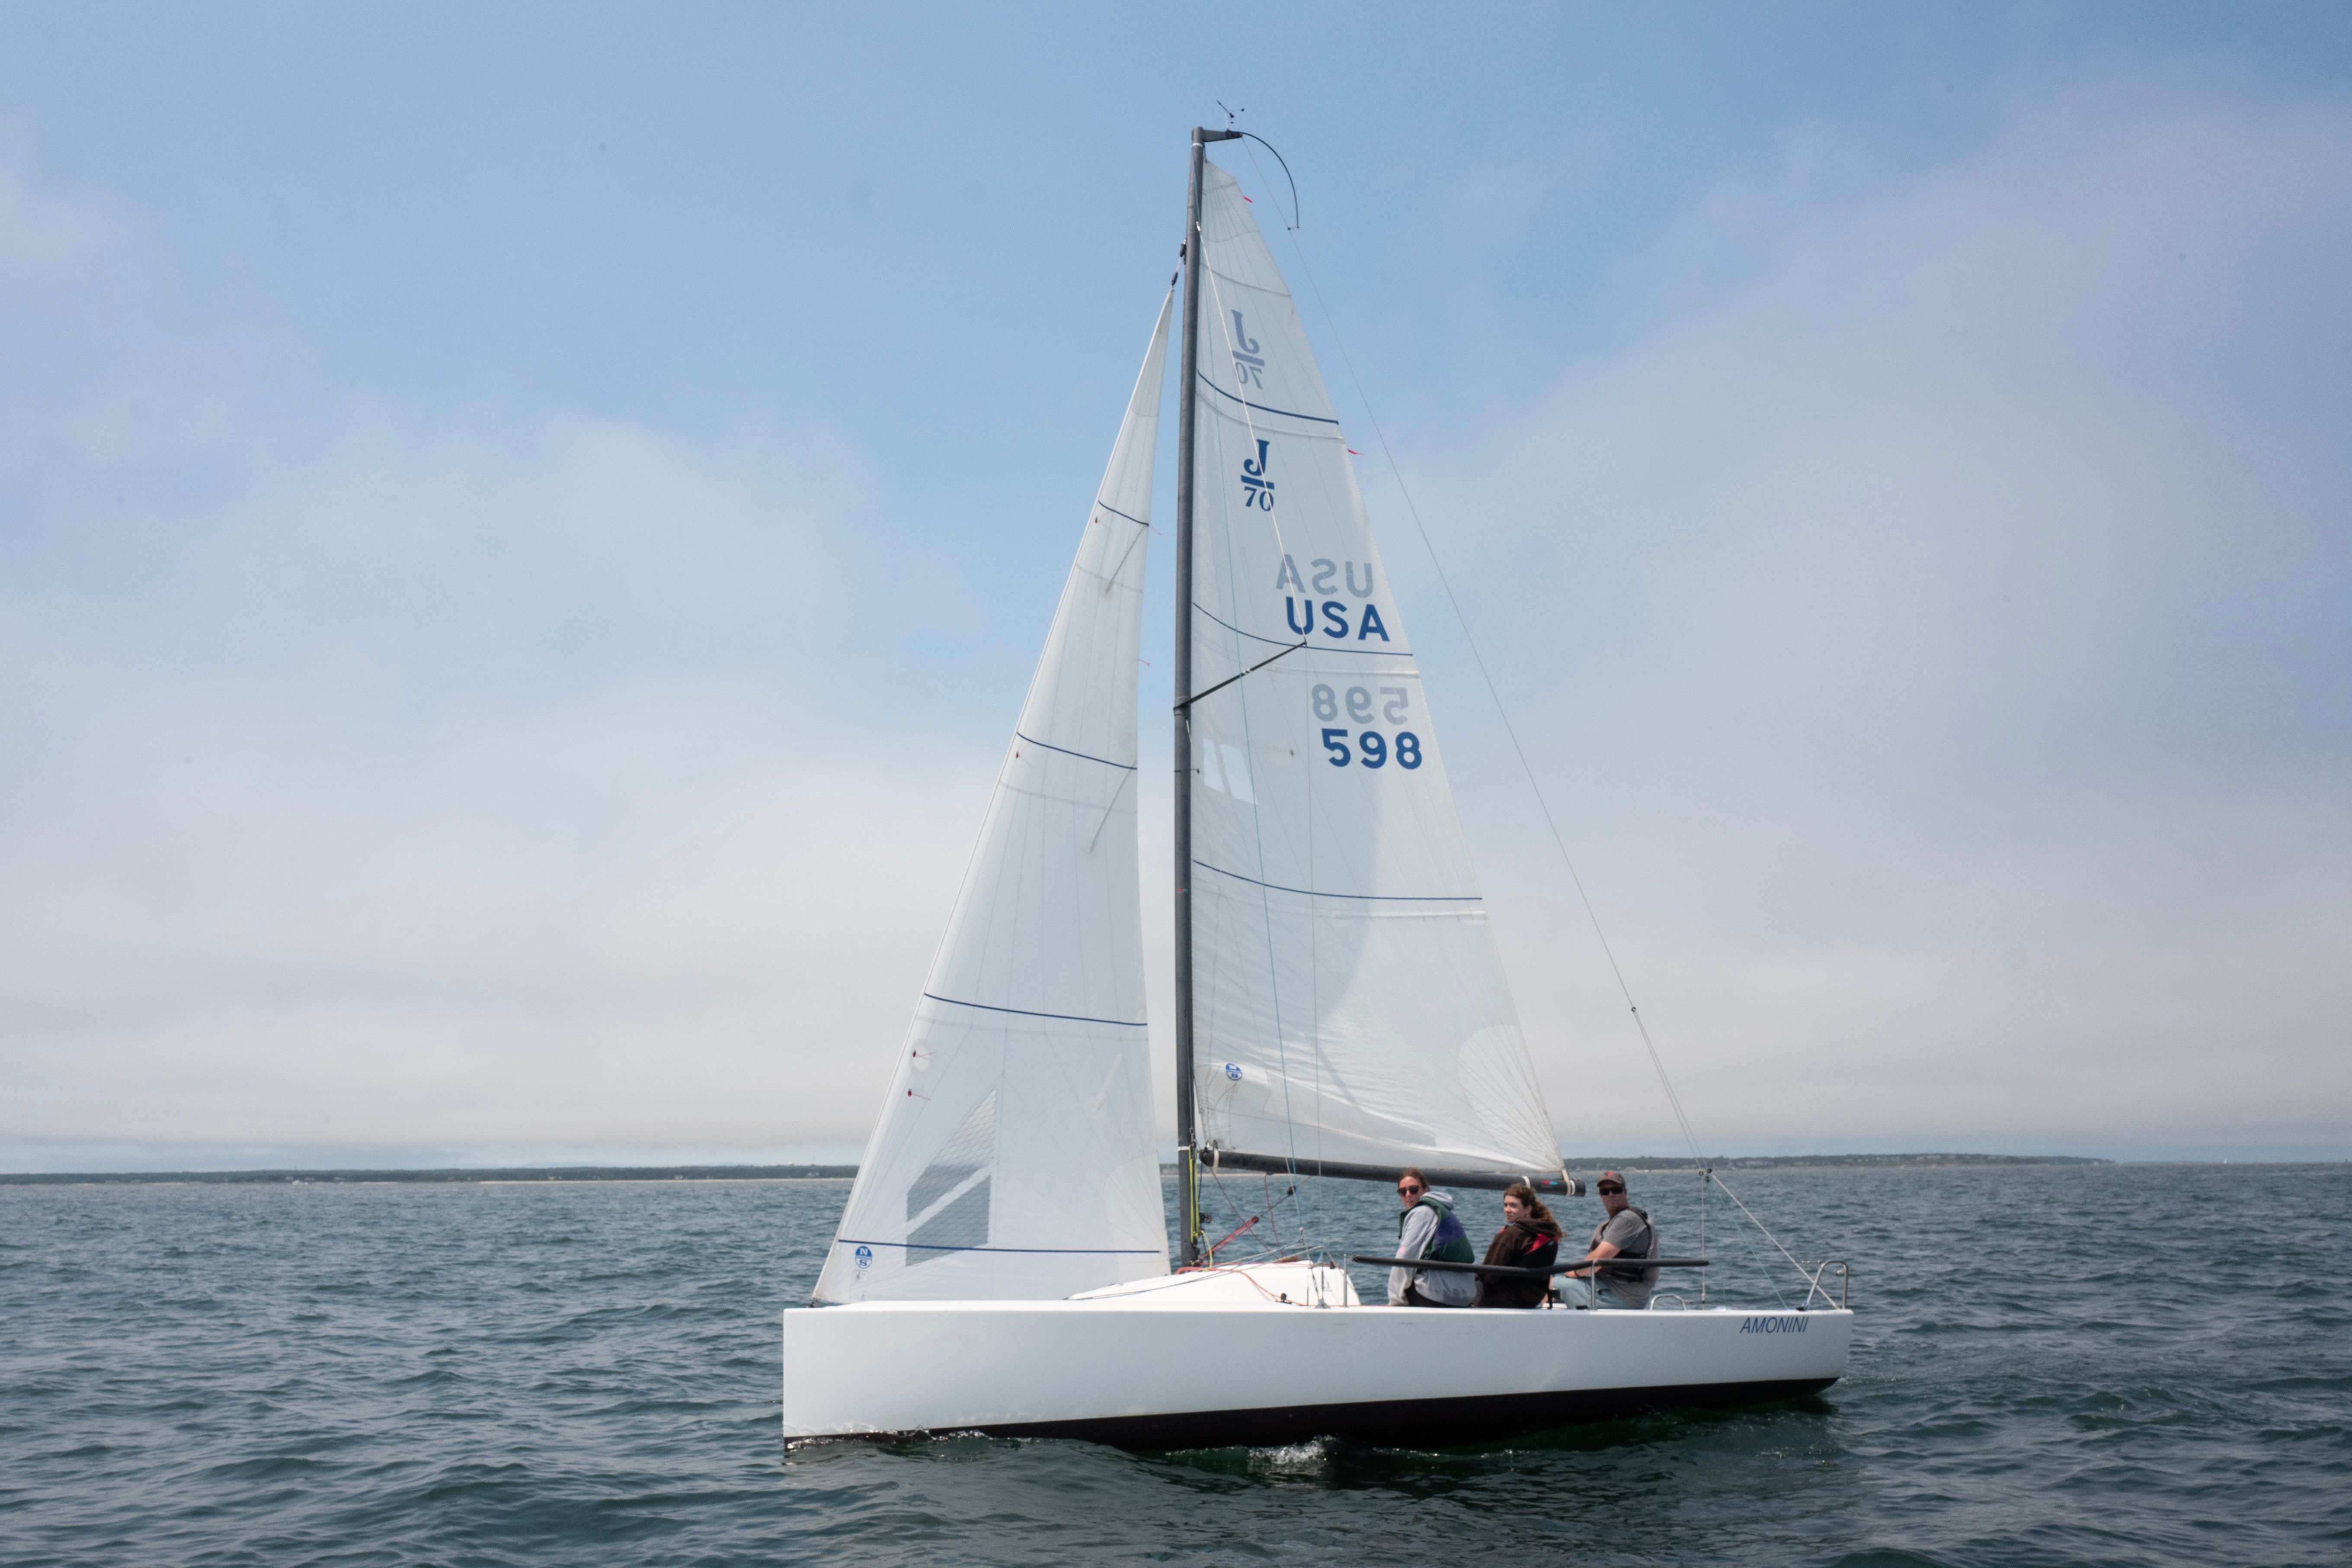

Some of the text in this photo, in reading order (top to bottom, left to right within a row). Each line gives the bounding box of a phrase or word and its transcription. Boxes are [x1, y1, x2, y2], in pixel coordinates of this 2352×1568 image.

[1243, 439, 1270, 476] J
[1244, 486, 1274, 511] 70
[1286, 596, 1390, 642] USA
[1321, 728, 1422, 769] 598
[1739, 1317, 1809, 1334] AMONINI
